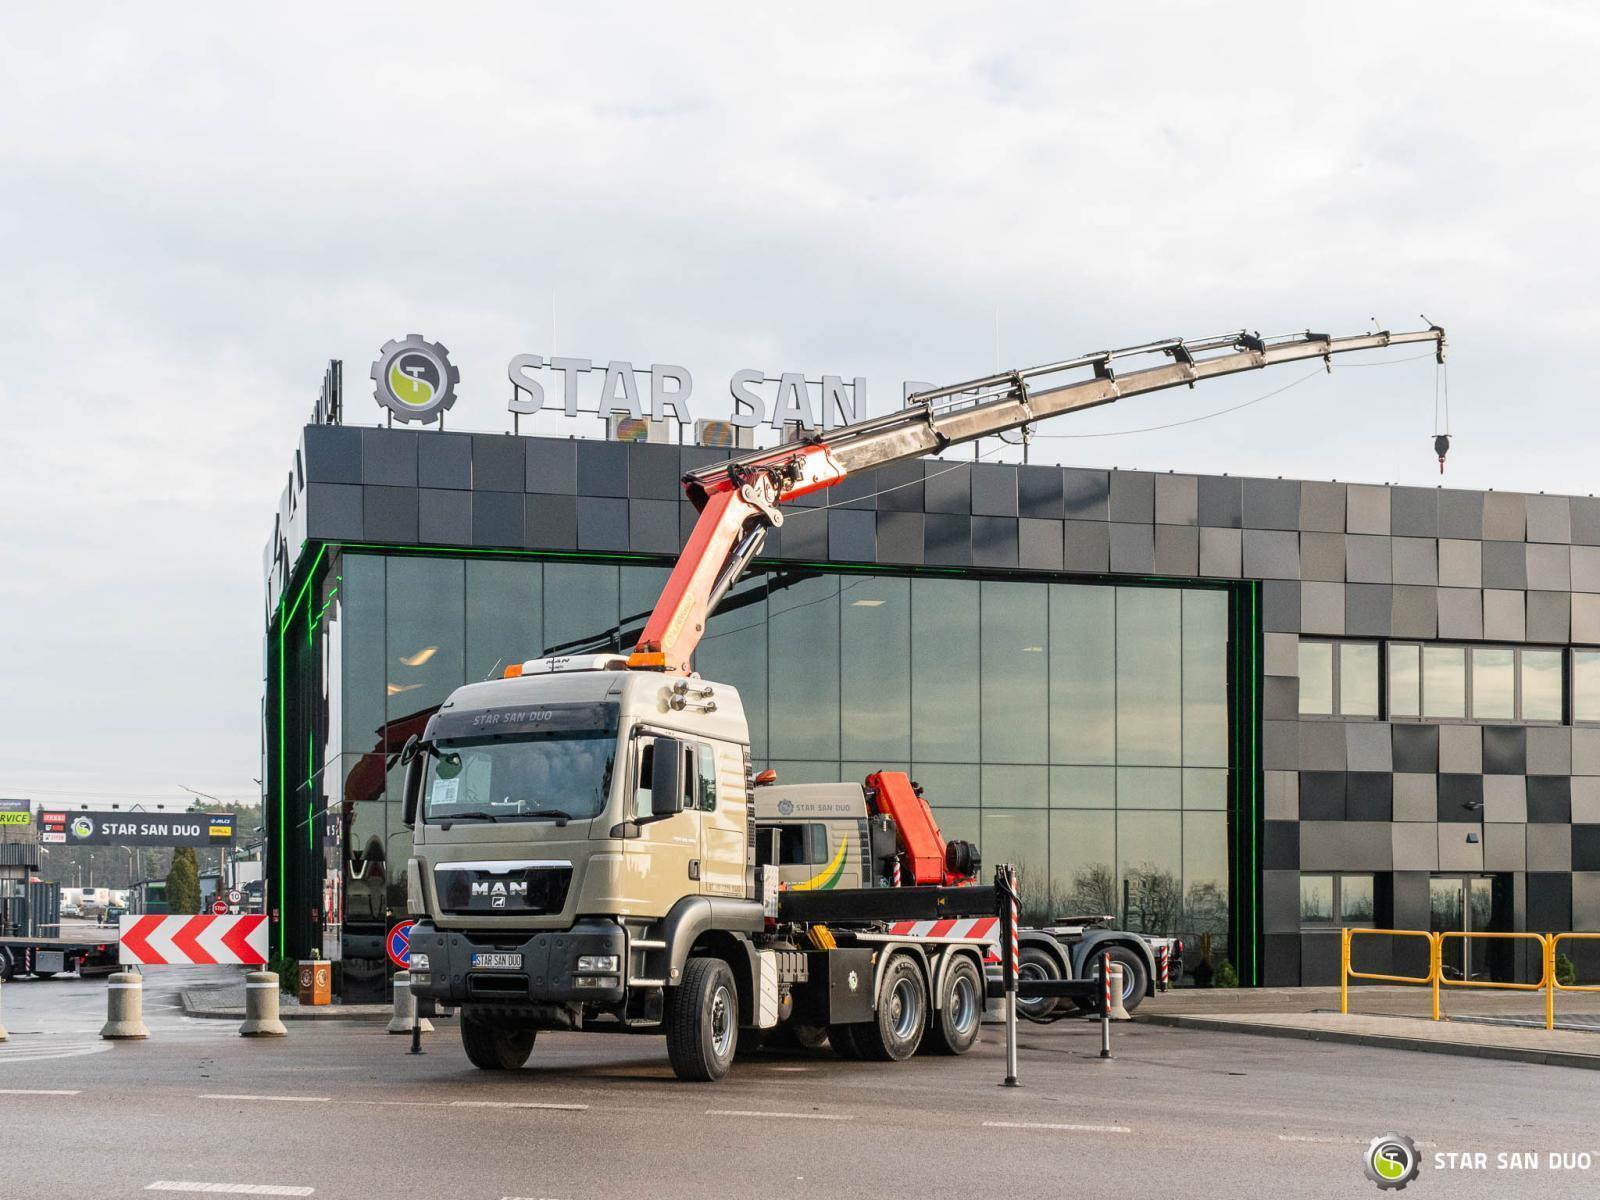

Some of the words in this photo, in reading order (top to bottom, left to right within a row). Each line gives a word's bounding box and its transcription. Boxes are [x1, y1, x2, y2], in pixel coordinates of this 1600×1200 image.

[508, 353, 692, 424] STAR
[730, 369, 867, 431] SAN
[472, 713, 500, 726] STAR
[503, 712, 526, 723] SAN
[529, 710, 553, 721] DUO
[101, 823, 137, 835] STAR
[140, 824, 168, 836] SAN
[172, 825, 200, 836] DUO
[472, 882, 527, 895] MAN
[476, 954, 493, 966] STAR
[494, 954, 506, 966] SAN
[508, 954, 521, 966] DUO
